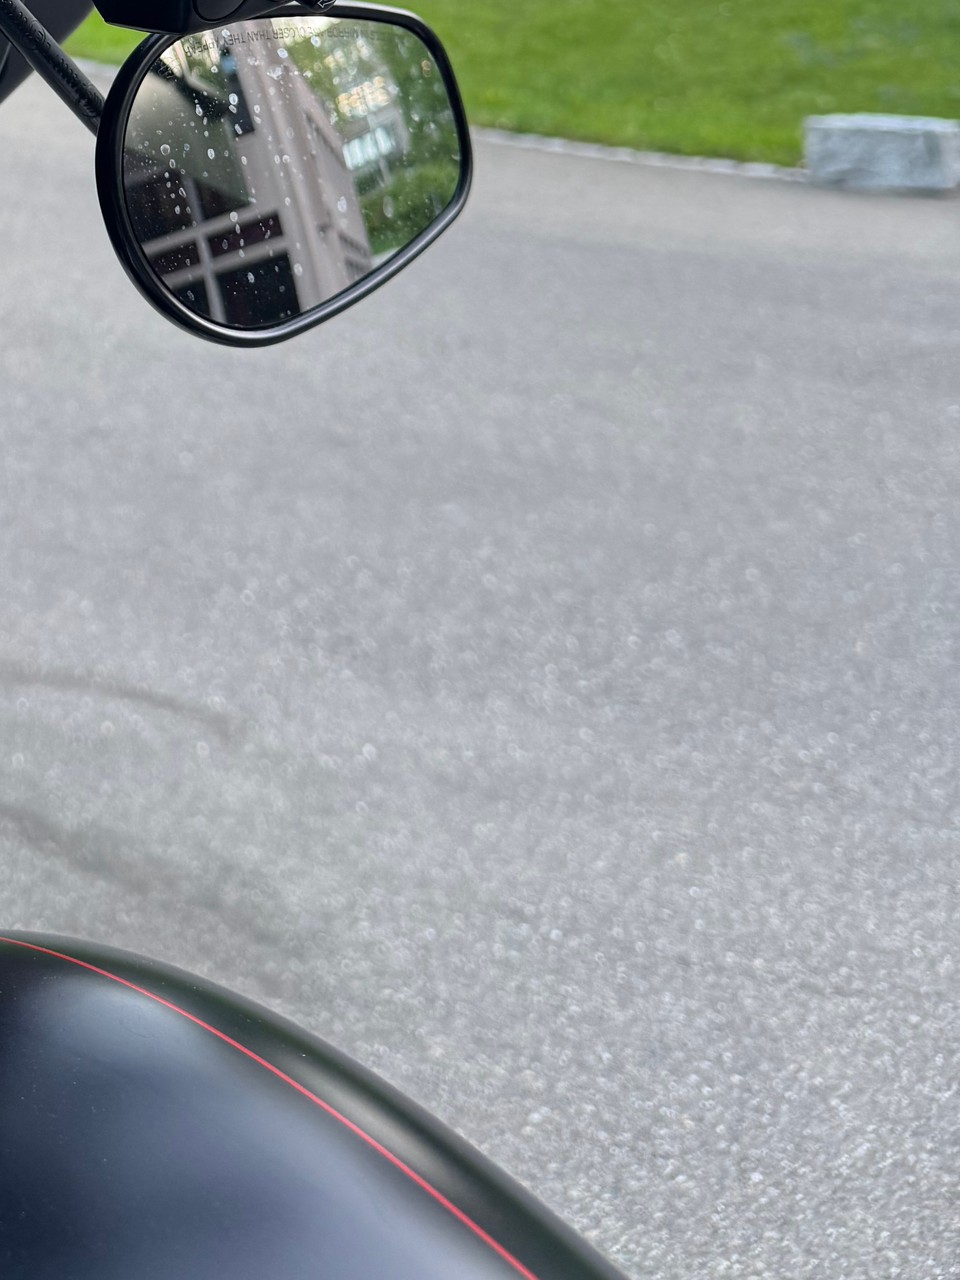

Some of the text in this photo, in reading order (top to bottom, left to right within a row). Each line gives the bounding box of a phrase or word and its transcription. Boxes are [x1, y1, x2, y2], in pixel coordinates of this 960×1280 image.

[223, 32, 246, 46] THEY
[246, 29, 271, 42] THAN
[271, 26, 306, 40] CLOSER
